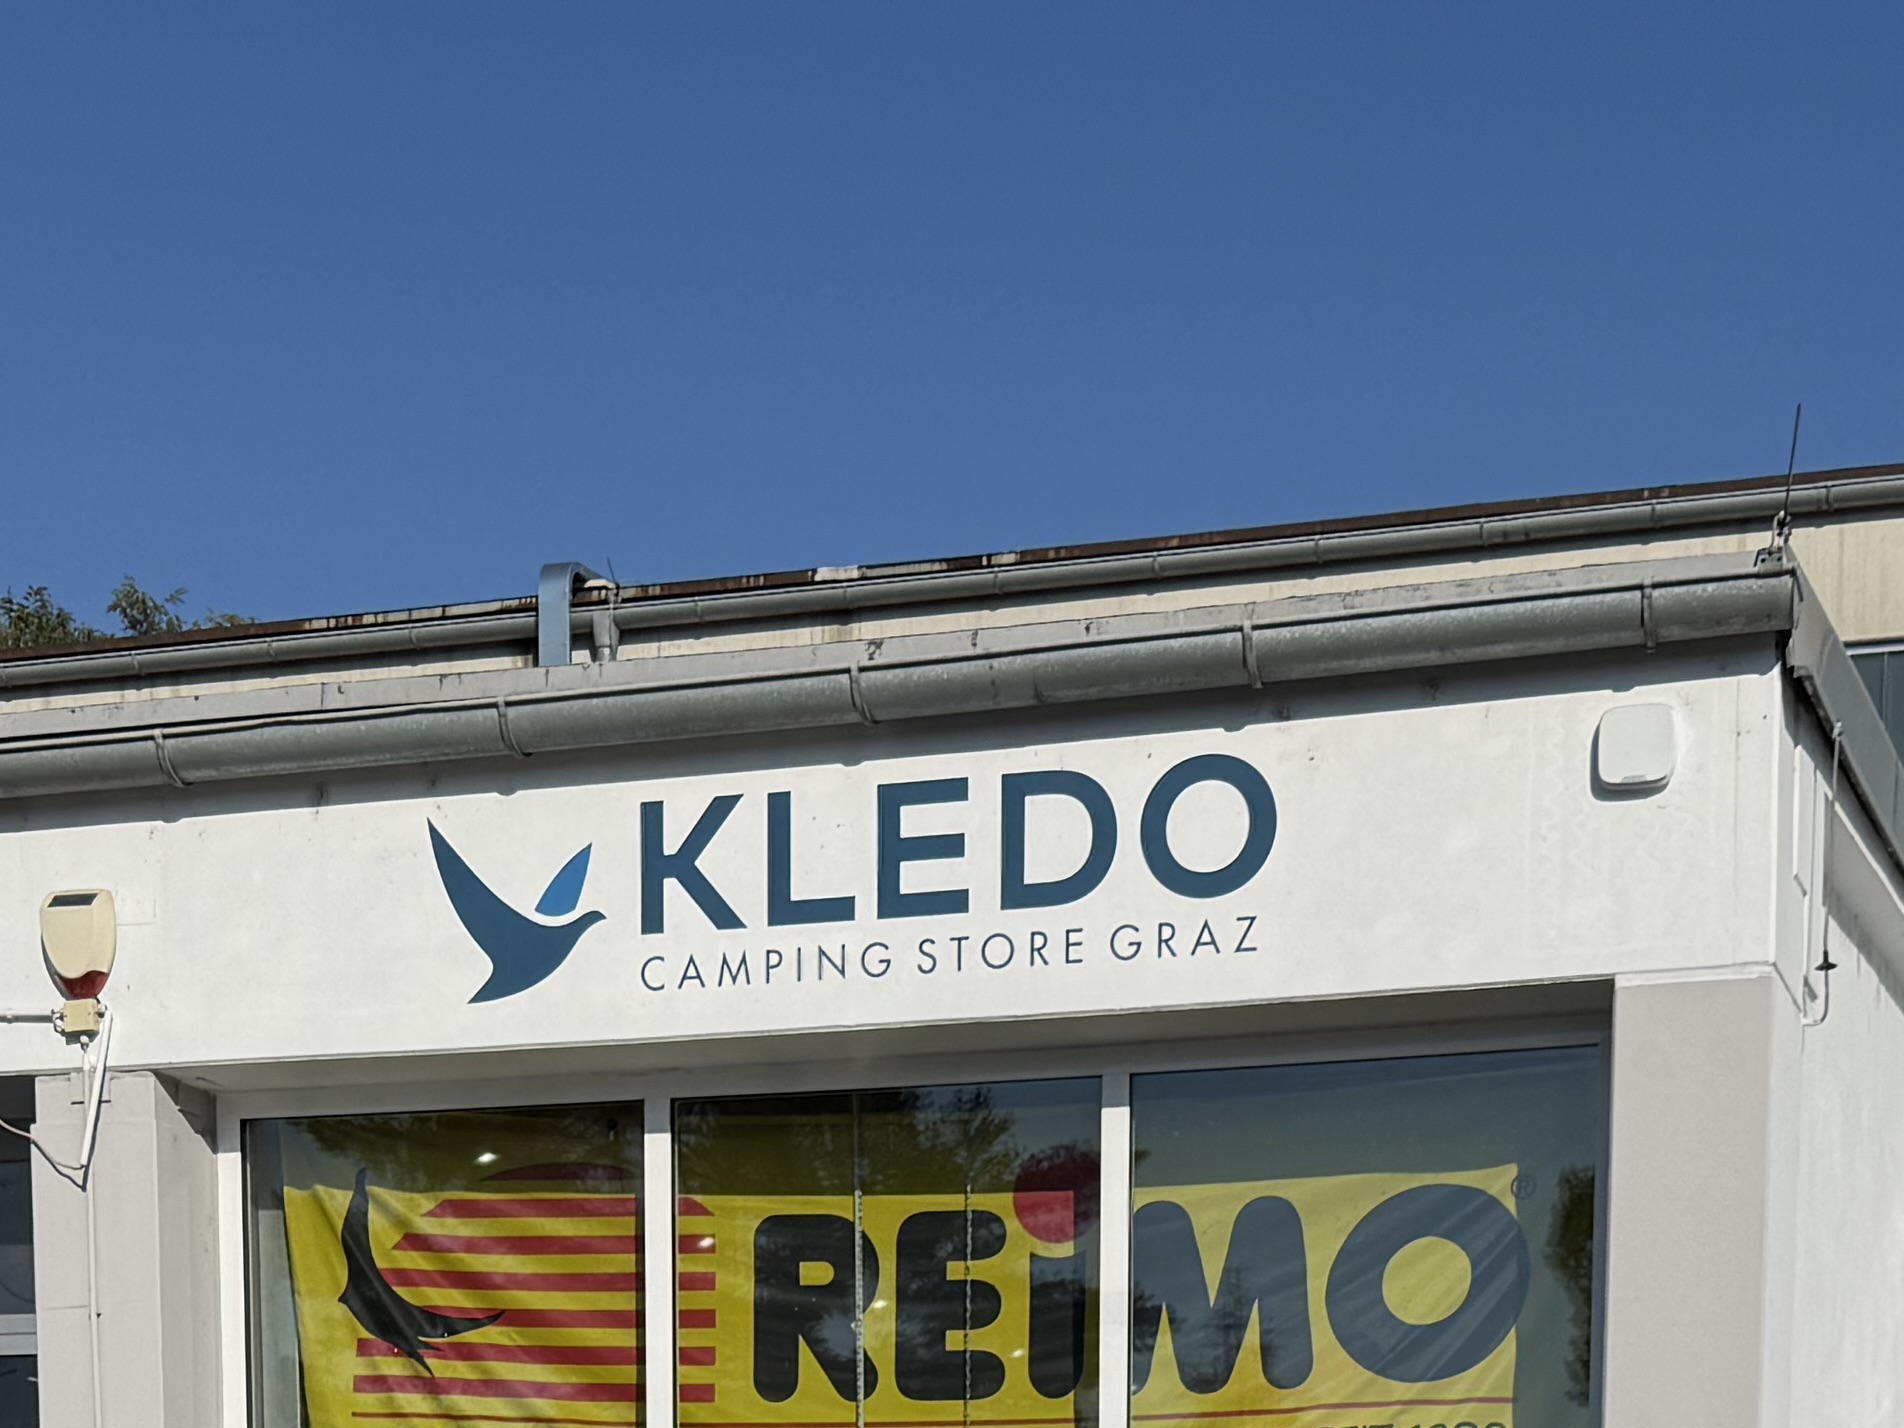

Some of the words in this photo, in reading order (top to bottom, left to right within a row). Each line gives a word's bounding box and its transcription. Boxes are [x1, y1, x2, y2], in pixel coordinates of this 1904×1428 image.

[640, 753, 1278, 935] KLEDO
[640, 941, 892, 992] CAMPING
[917, 929, 1086, 977] STORE
[1110, 915, 1259, 962] GRAZ
